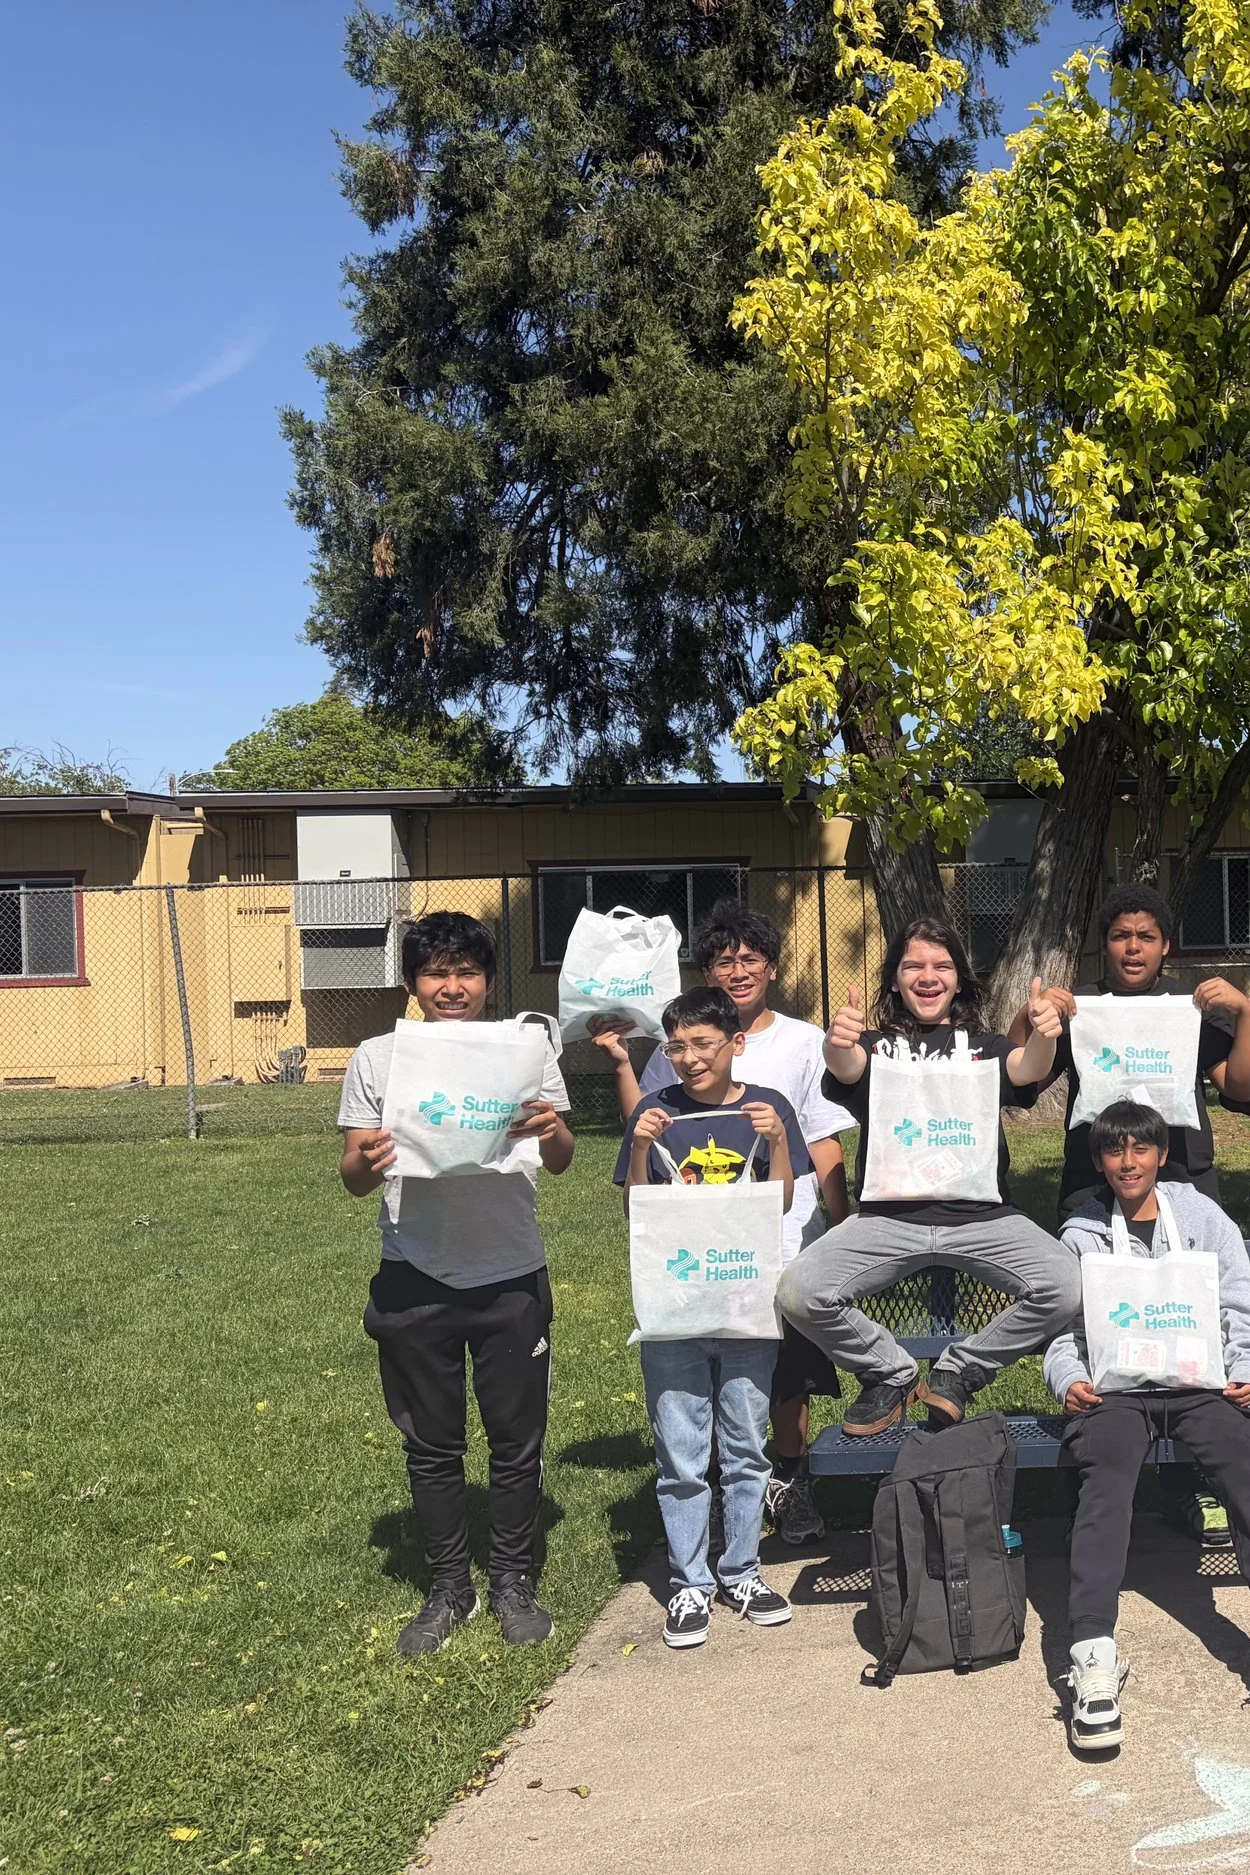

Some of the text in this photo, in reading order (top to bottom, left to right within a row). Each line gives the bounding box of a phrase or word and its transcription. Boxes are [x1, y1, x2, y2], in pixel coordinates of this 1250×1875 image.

[605, 983, 655, 997] Health
[1124, 1046, 1171, 1060] Sutter
[1125, 1060, 1173, 1074] Health
[461, 1095, 519, 1114] Sutter
[927, 1118, 974, 1132] Sutter
[927, 1132, 977, 1147] Health
[705, 1248, 755, 1264] Sutter
[705, 1265, 759, 1281] Health
[1143, 1301, 1194, 1317] Sutter
[1145, 1315, 1198, 1330] Health
